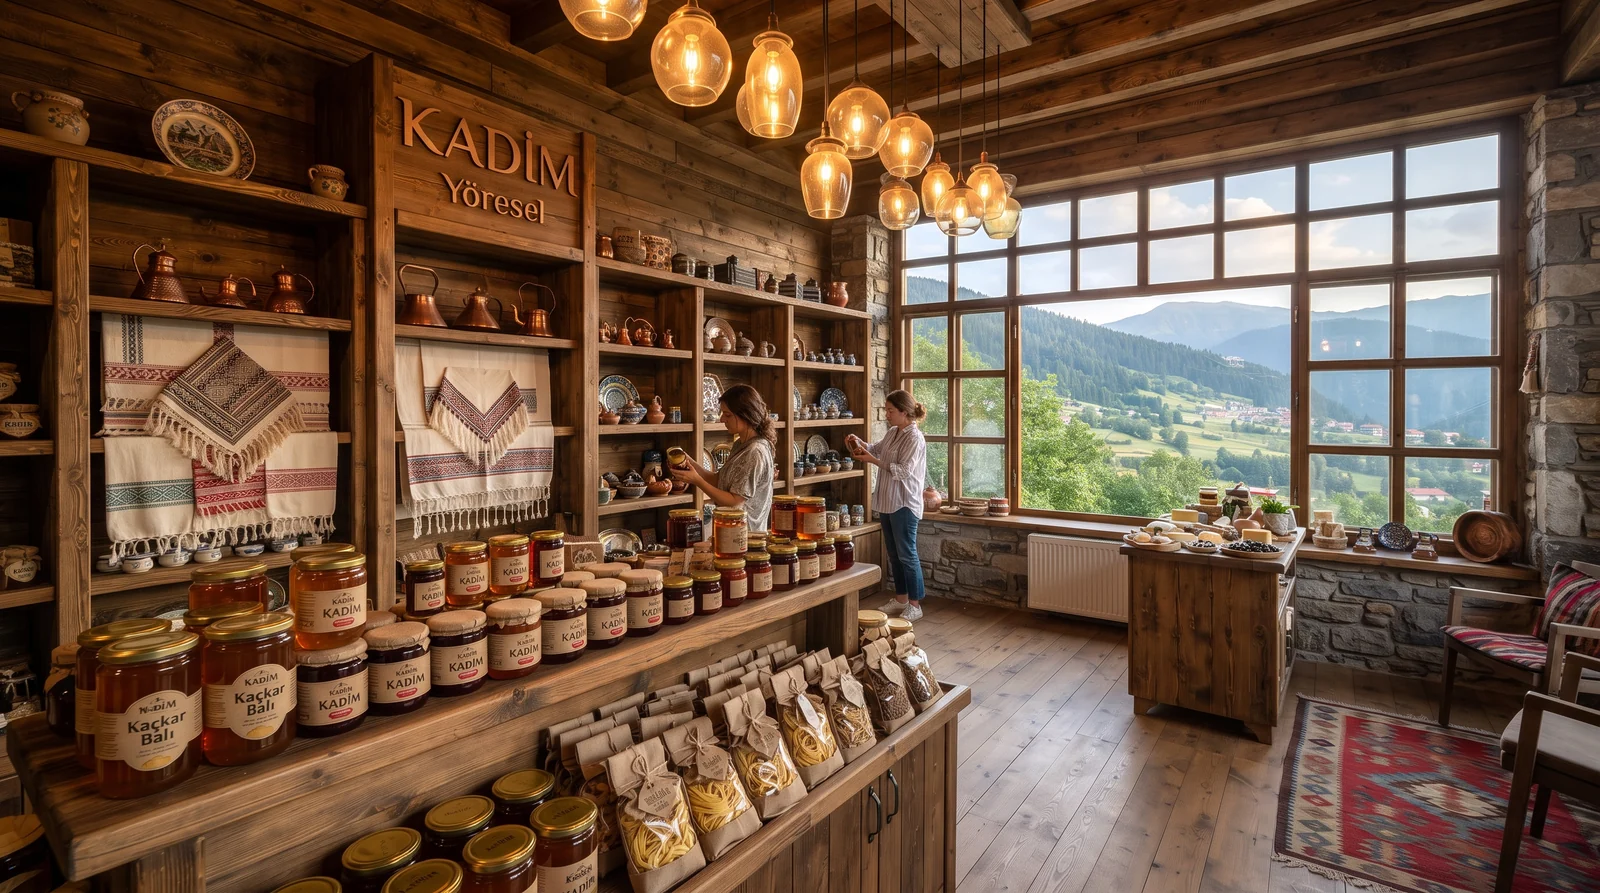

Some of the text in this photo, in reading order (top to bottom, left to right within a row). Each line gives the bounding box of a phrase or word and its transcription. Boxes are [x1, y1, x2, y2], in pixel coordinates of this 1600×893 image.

[397, 96, 578, 198] KADİM
[440, 172, 544, 224] Yöresel
[323, 604, 361, 619] KADİM
[244, 673, 278, 687] KADİM
[234, 685, 286, 705] Kaçkar
[318, 692, 361, 711] KADİM
[247, 699, 275, 717] Balı
[127, 711, 187, 734] Kaçkar
[141, 728, 174, 746] Balı
